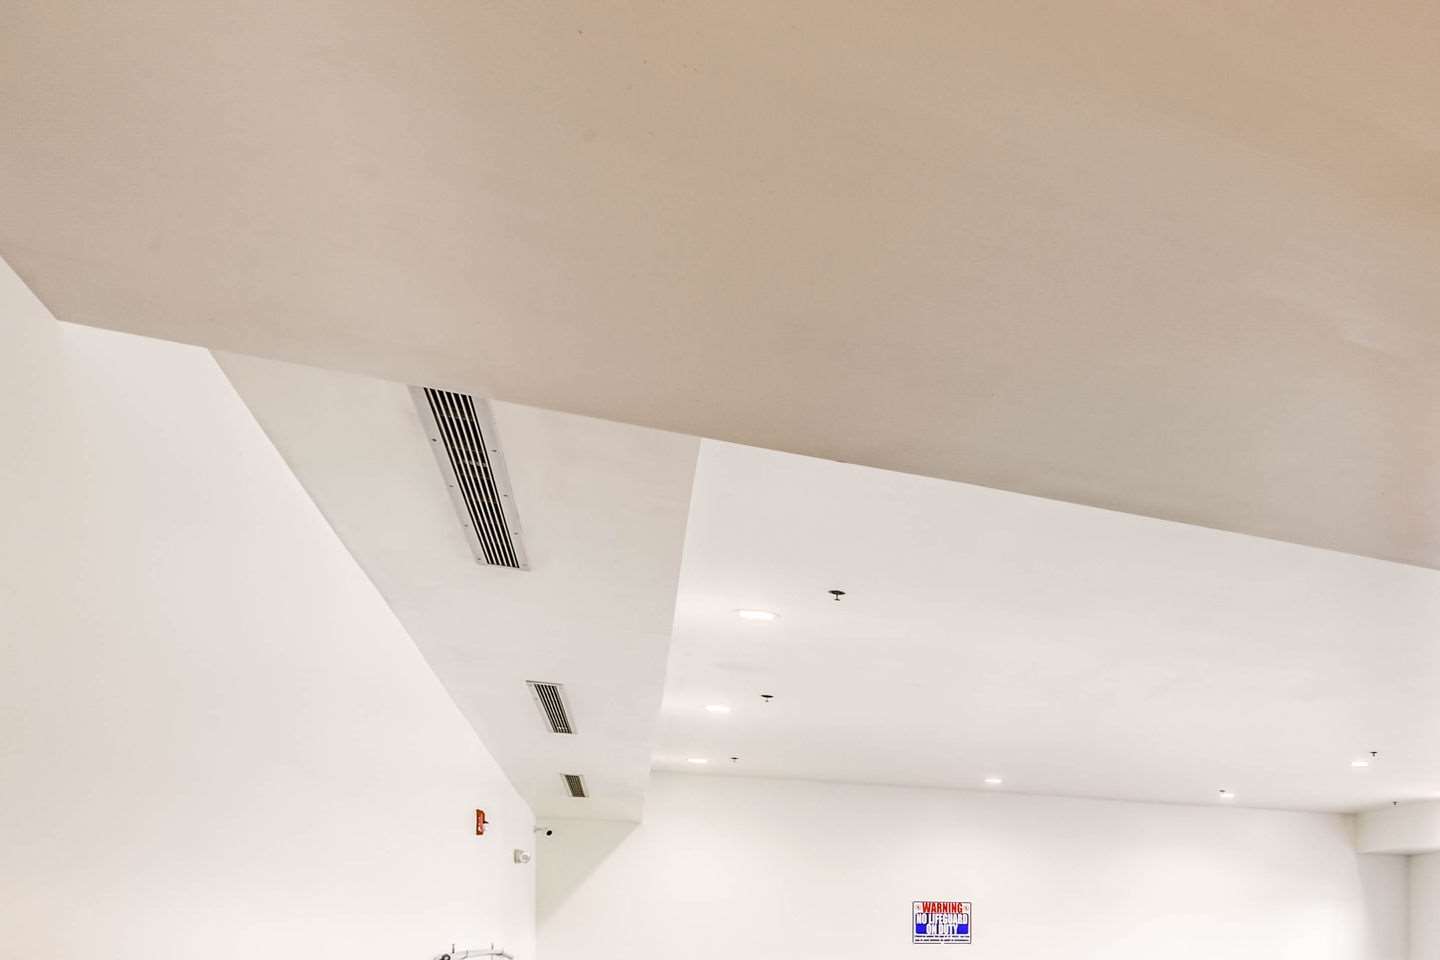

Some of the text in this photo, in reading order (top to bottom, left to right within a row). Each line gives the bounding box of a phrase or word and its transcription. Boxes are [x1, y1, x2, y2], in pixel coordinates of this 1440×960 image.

[922, 902, 963, 913] WARNING
[916, 913, 927, 924] NO
[926, 924, 958, 934] ON DUTY
